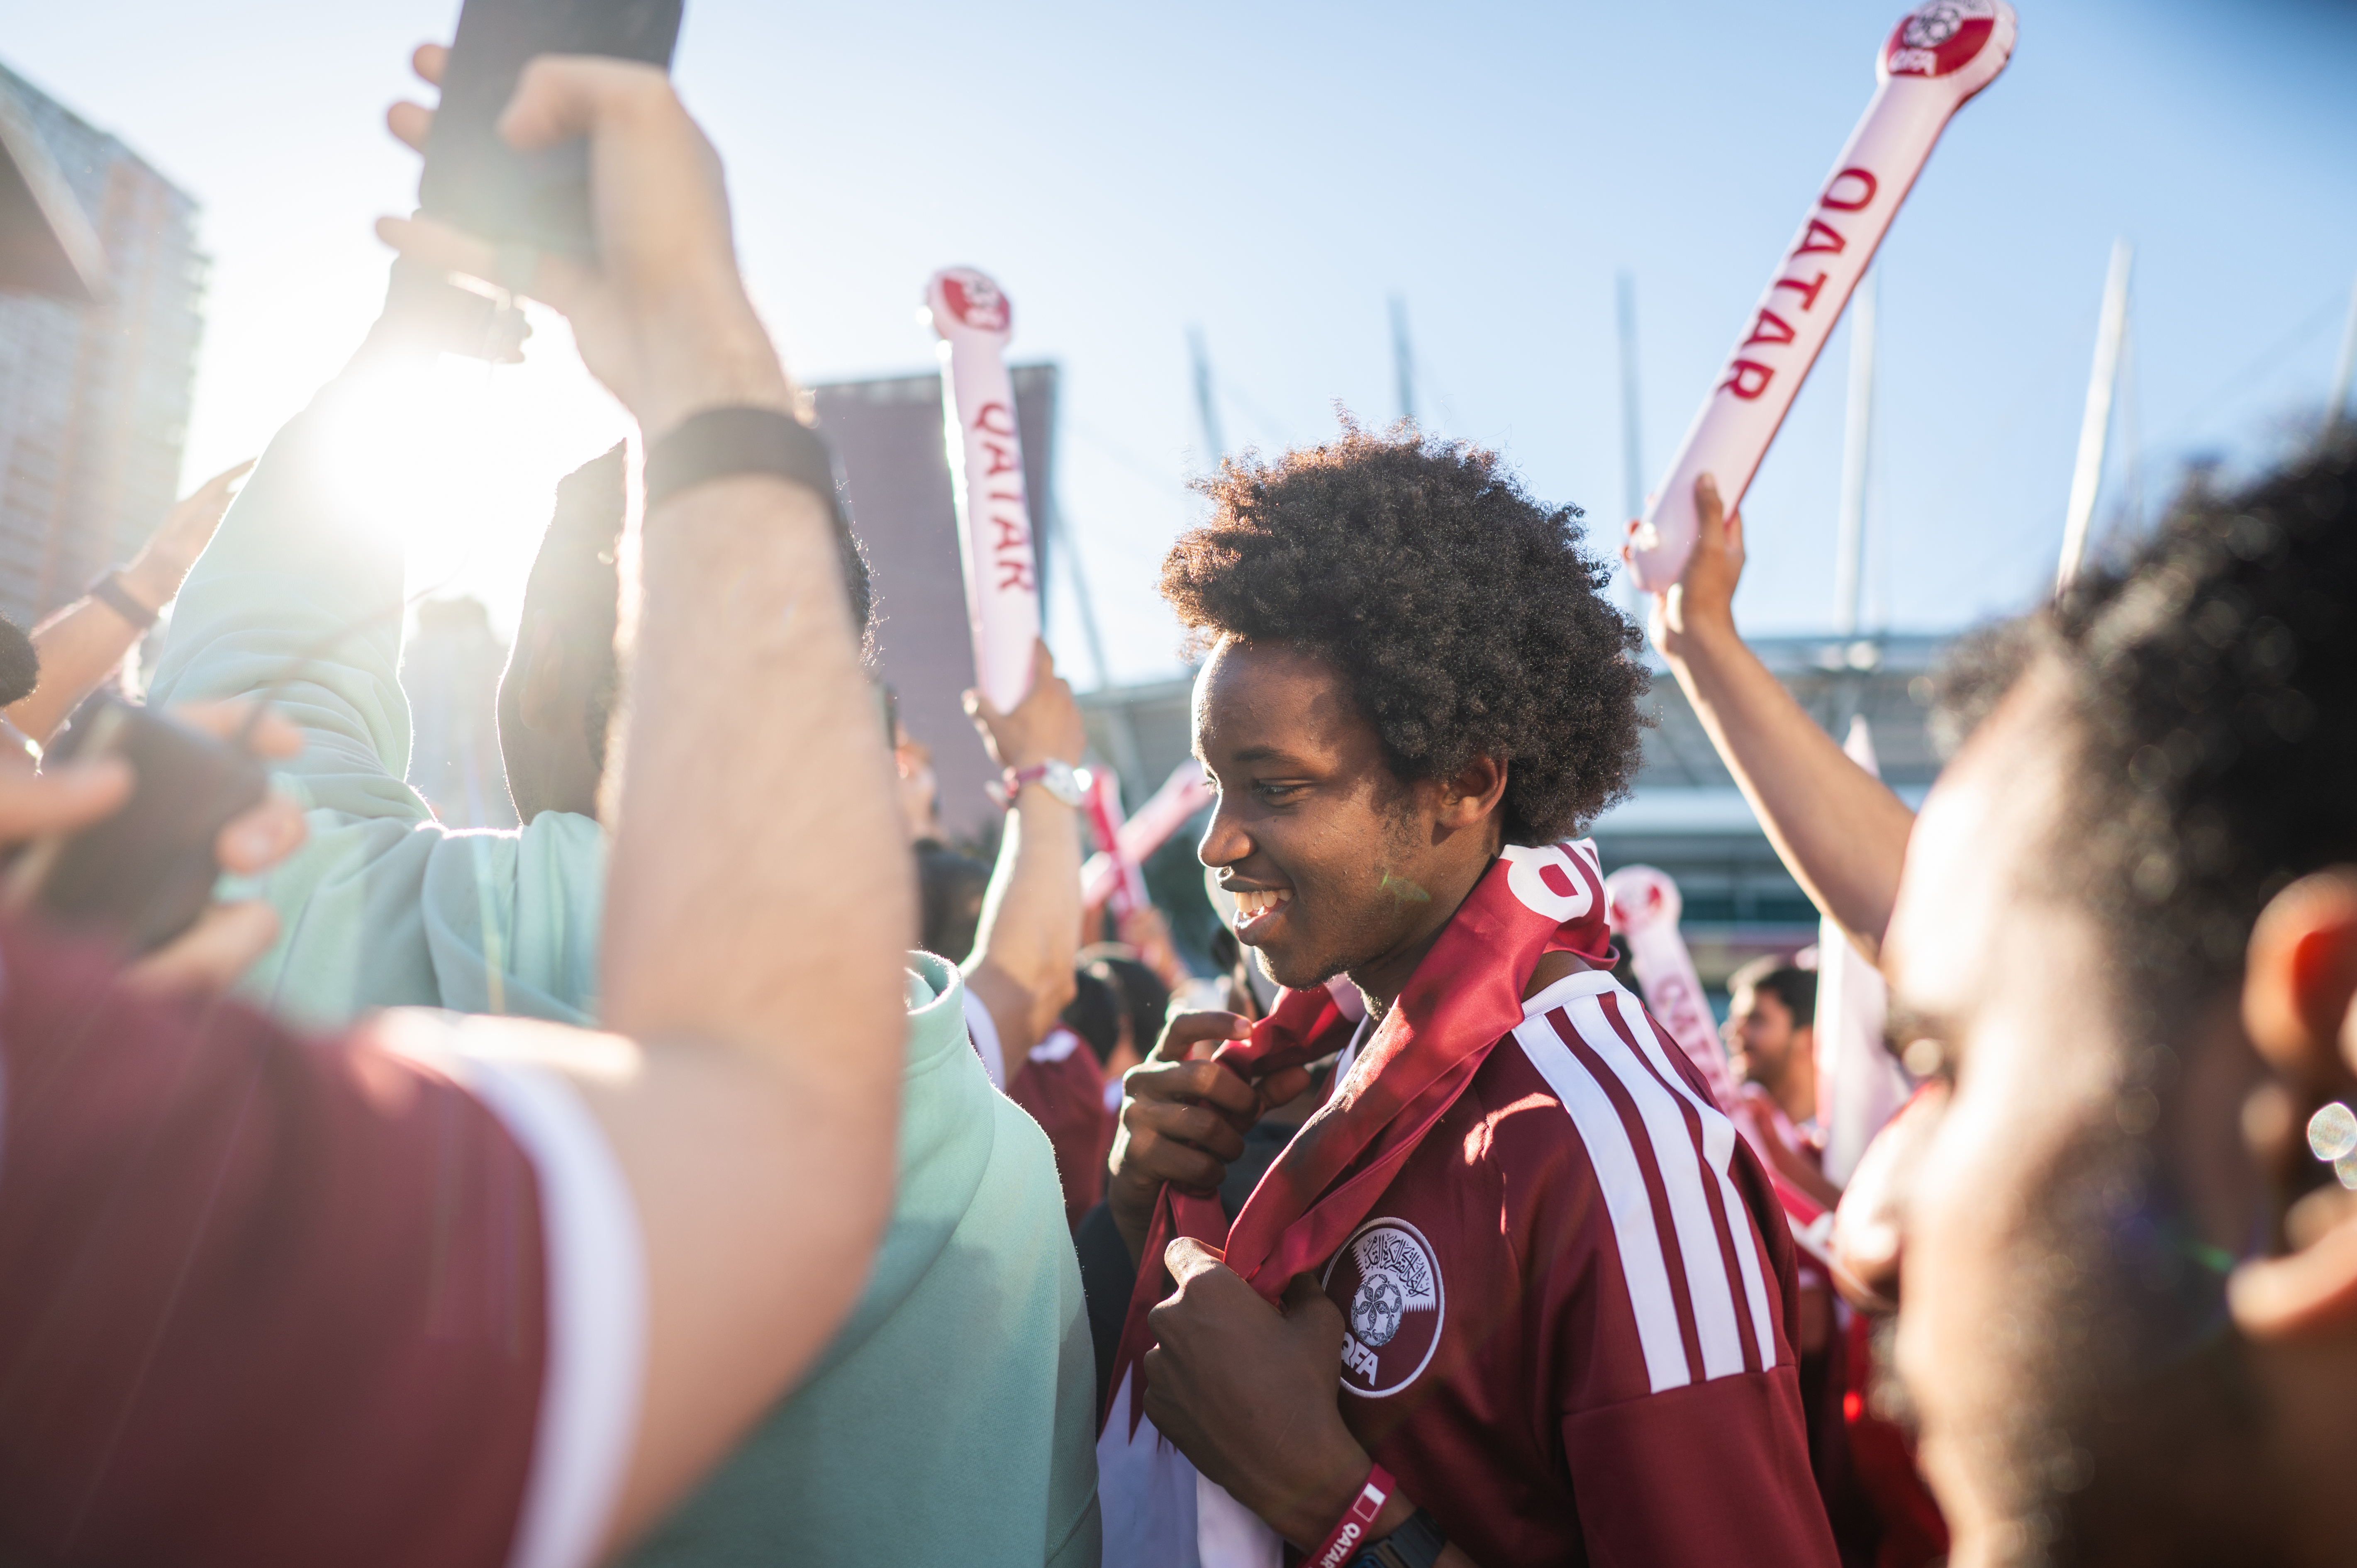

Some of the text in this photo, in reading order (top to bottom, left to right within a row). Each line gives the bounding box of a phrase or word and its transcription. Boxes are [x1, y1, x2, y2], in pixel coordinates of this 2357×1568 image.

[1715, 168, 1878, 402] QATAR
[1341, 1332, 1378, 1386] QFA
[1319, 1522, 1361, 1568] QATAR
